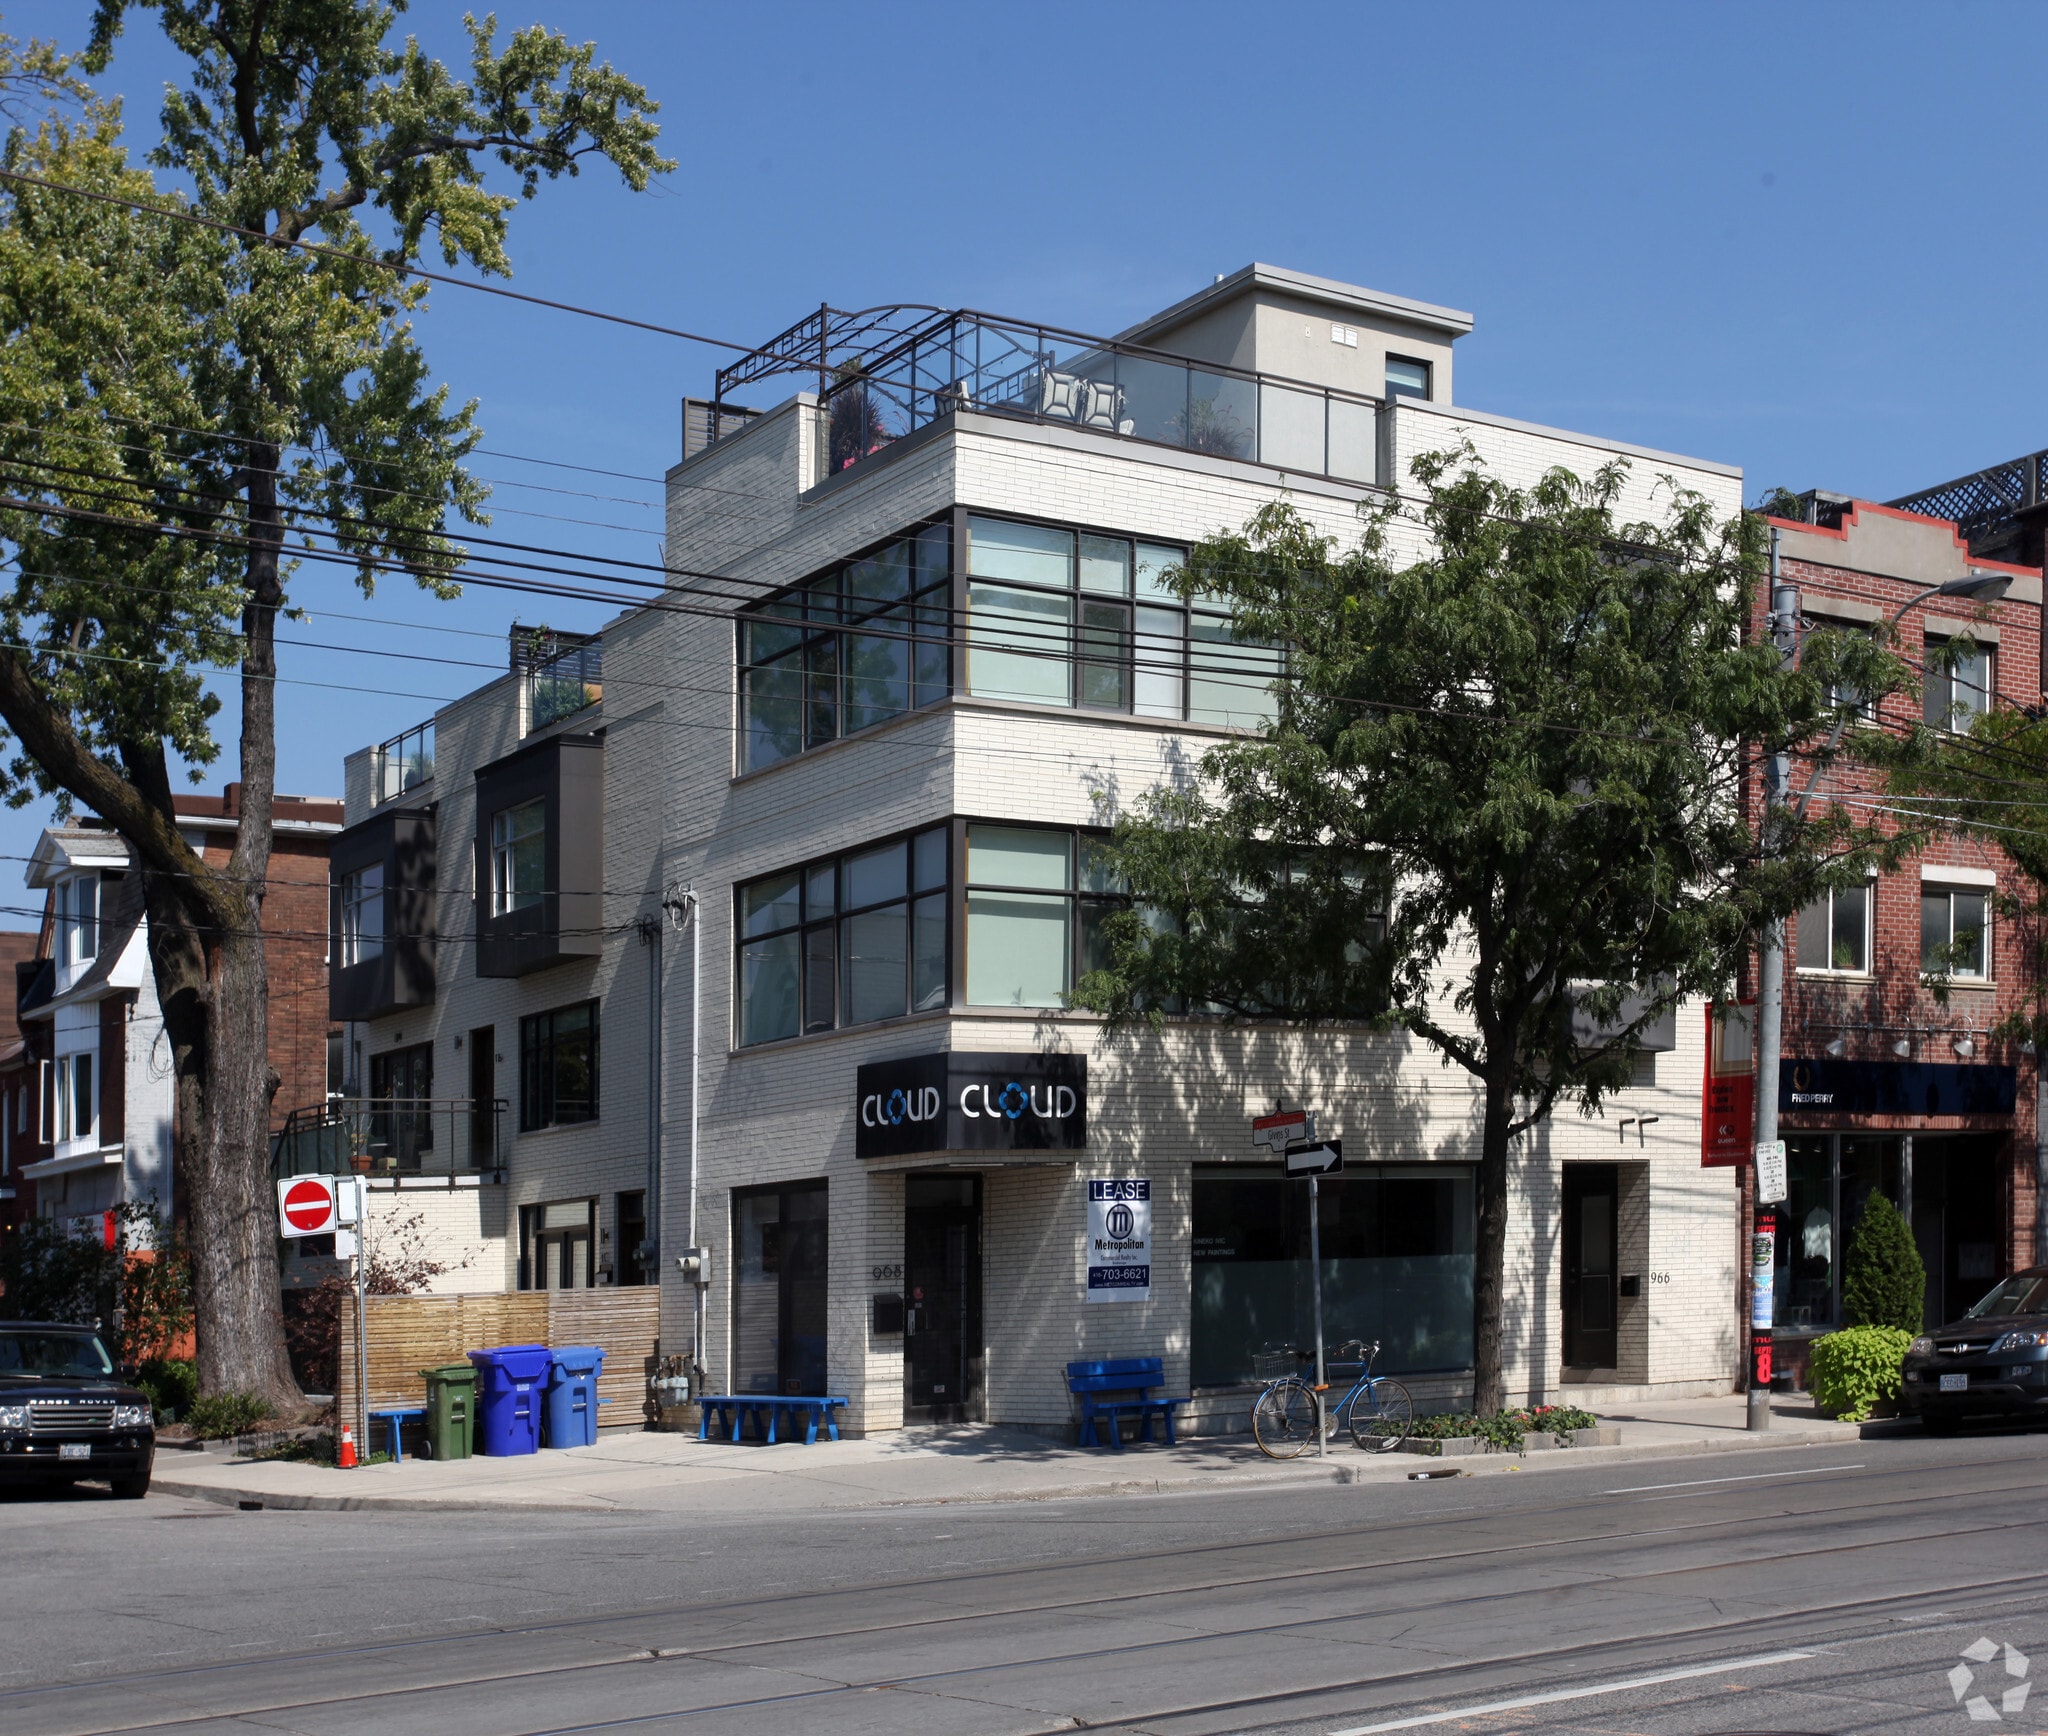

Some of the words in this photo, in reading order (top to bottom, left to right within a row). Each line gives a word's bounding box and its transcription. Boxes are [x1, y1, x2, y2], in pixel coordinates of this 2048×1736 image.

[960, 1081, 1077, 1120] CLOUD
[1791, 1093, 1810, 1103] FRED
[1811, 1093, 1834, 1103] PERRY
[862, 1086, 940, 1128] CLOUD
[1267, 1128, 1284, 1140] Givins
[1284, 1128, 1290, 1139] St
[1093, 1182, 1146, 1200] LEASE
[1094, 1238, 1144, 1253] Metropolitan
[872, 1264, 902, 1281] 968
[1650, 1271, 1670, 1284] 966
[1756, 1353, 1772, 1384] 8
